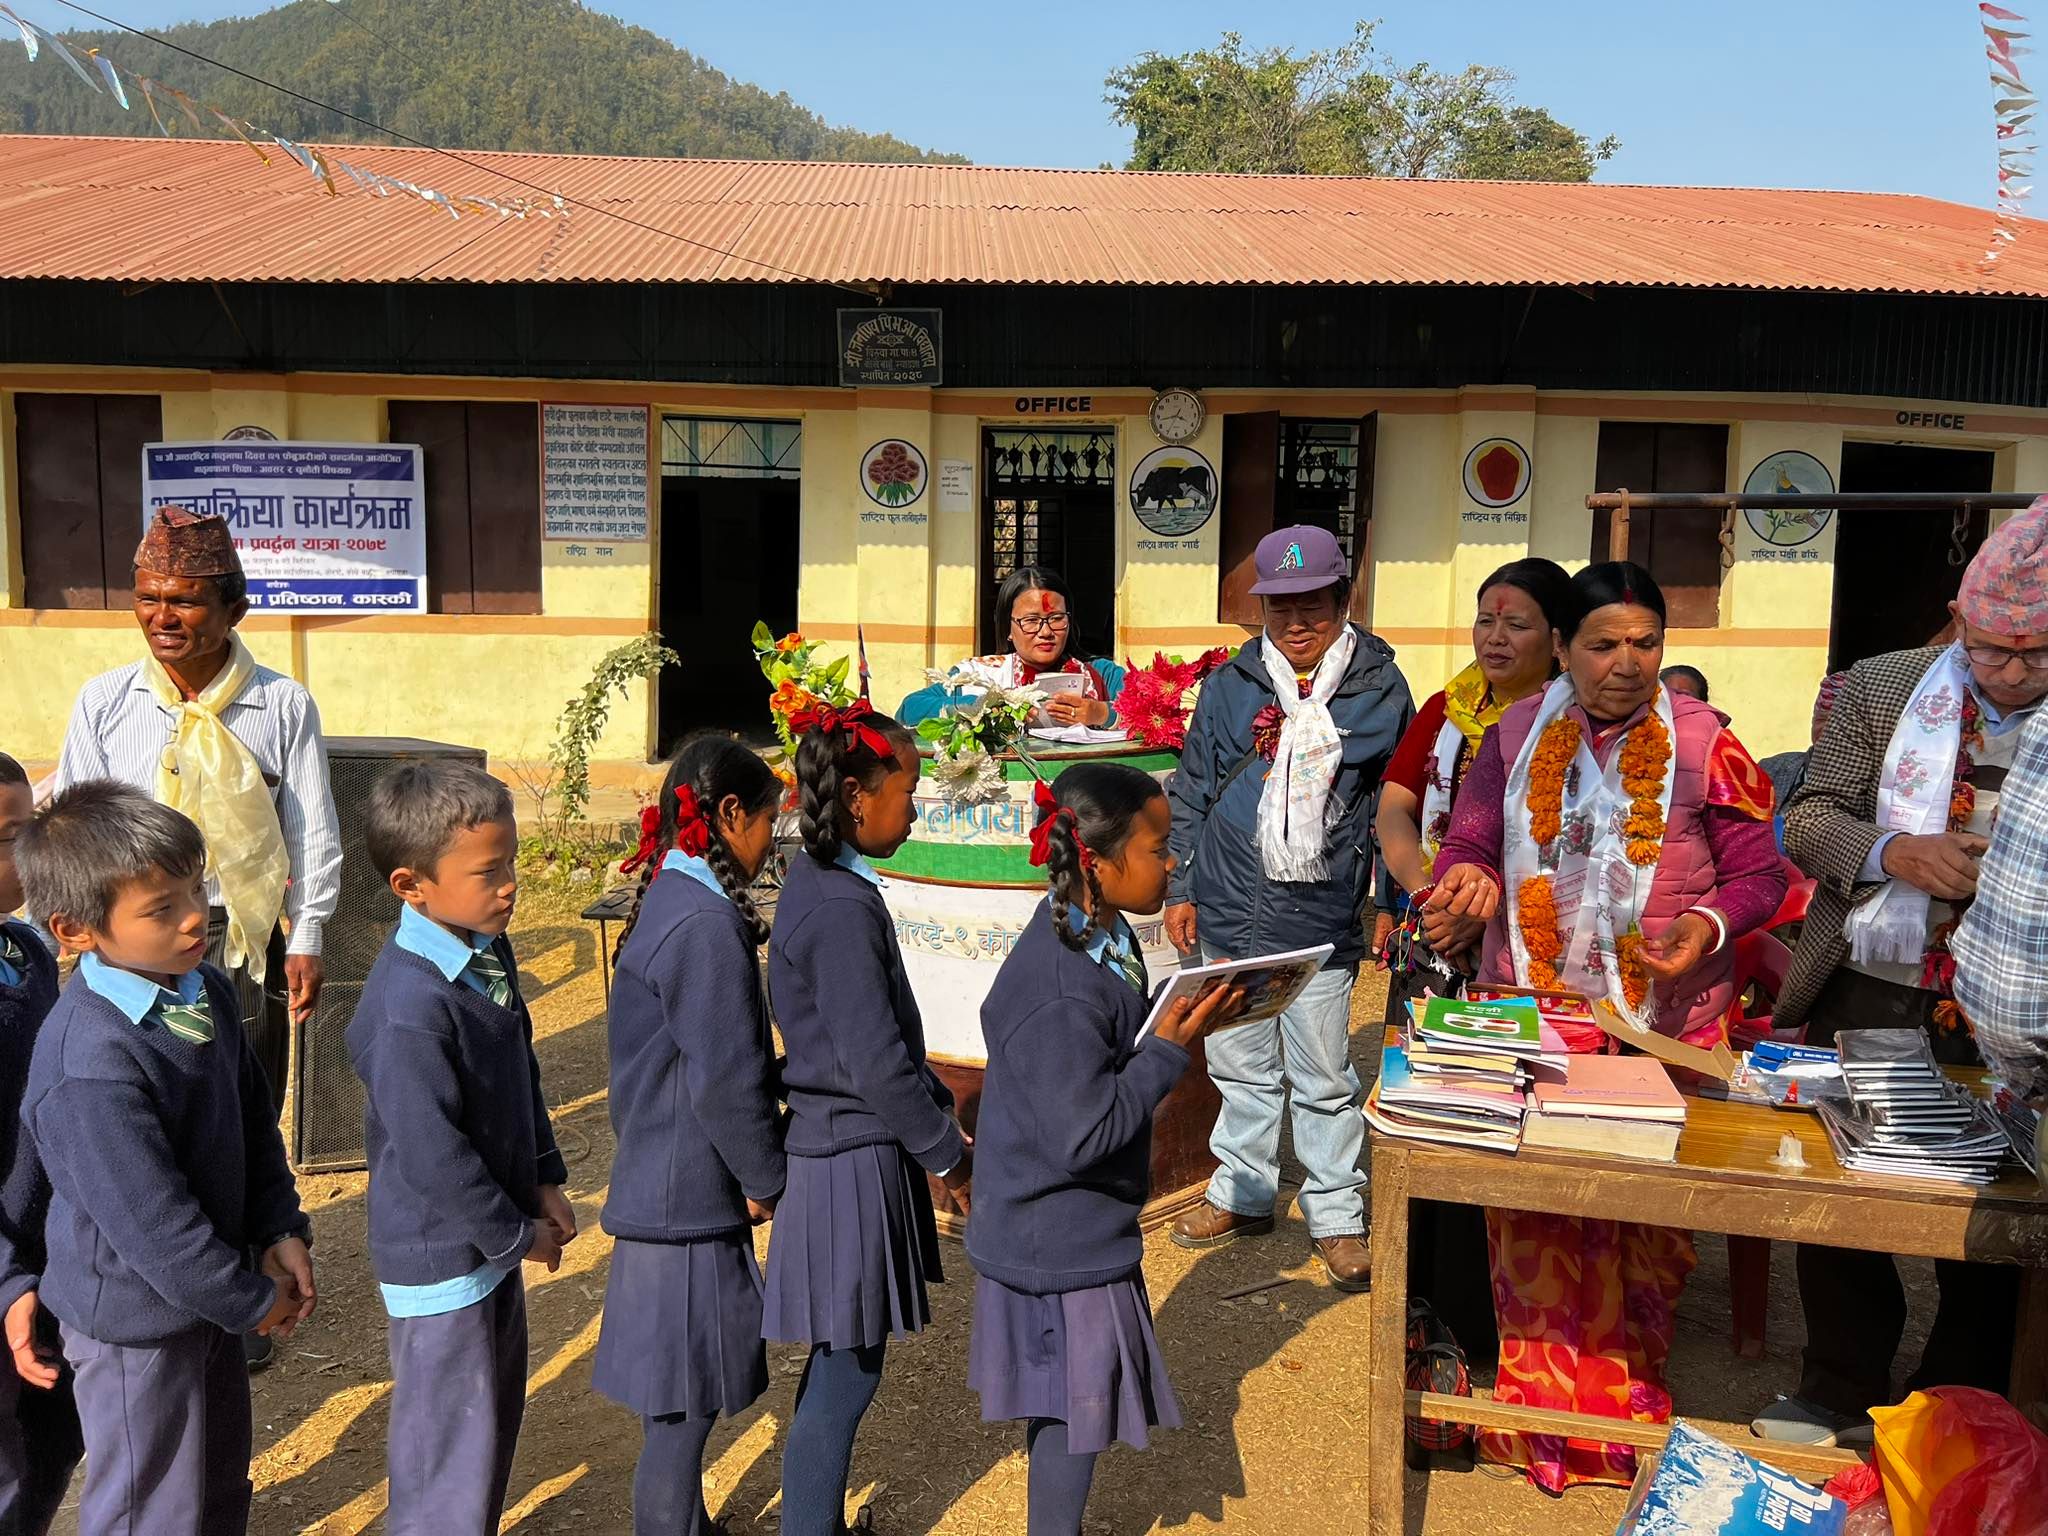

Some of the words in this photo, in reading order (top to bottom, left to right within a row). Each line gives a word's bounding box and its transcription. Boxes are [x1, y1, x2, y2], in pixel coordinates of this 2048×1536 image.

[1015, 397, 1091, 412] OFFICE
[1895, 411, 1965, 430] OFFICE
[293, 483, 413, 530] कार्यक्रम
[351, 591, 413, 606] कास्की
[1761, 1490, 1790, 1531] PAPER
